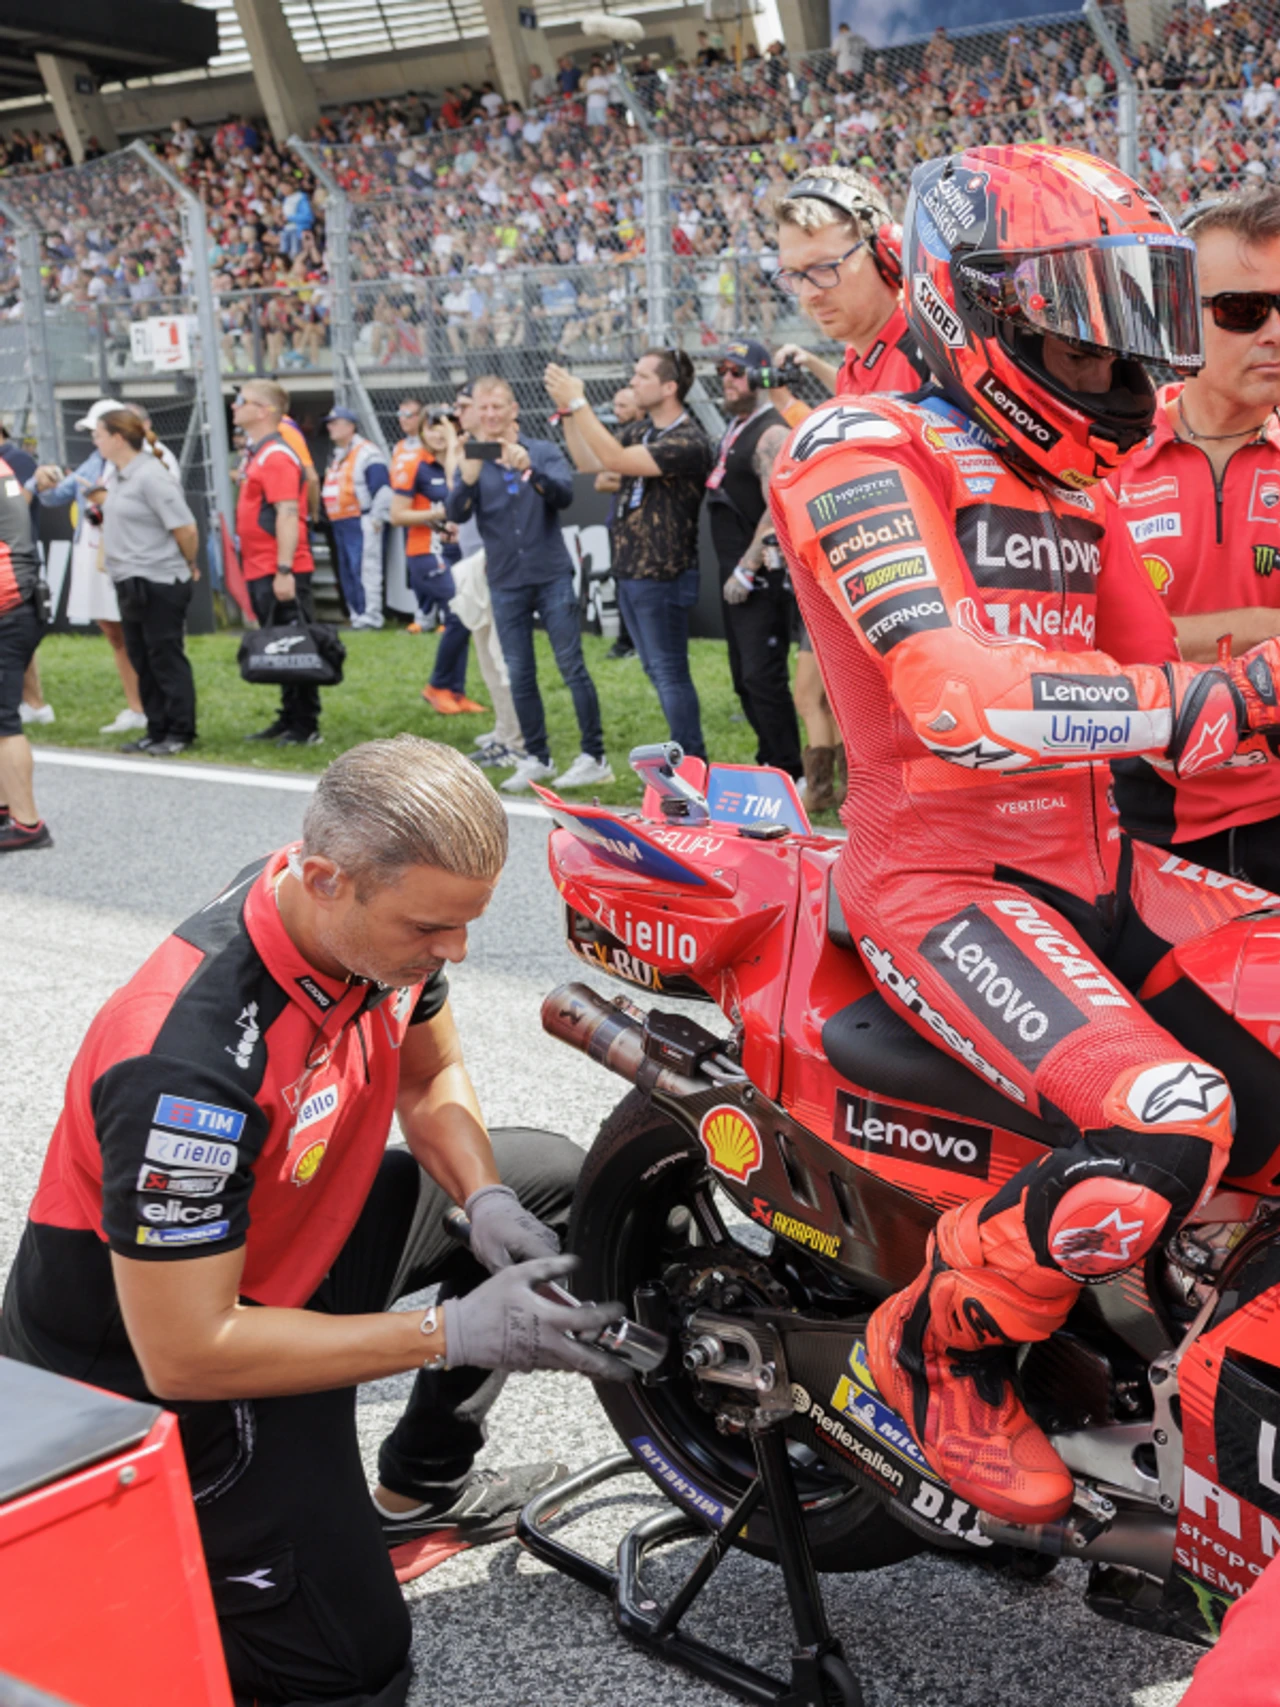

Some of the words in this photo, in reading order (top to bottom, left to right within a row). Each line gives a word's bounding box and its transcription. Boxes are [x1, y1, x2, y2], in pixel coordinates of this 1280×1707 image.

[917, 280, 960, 342] SHOEI
[982, 377, 1051, 442] Lenovo
[976, 520, 1102, 575] Lenovo
[1134, 517, 1176, 540] riello
[1040, 680, 1130, 702] Lenovo
[1051, 715, 1131, 750] Unipol
[742, 794, 782, 819] TIM
[996, 796, 1067, 815] VERTICAL
[994, 899, 1131, 1009] DUCATI
[940, 920, 1050, 1042] Lenovo
[860, 936, 1027, 1103] alpinestars
[197, 1108, 234, 1133] TIM
[845, 1104, 977, 1163] Lenovo
[171, 1140, 232, 1167] riello
[143, 1199, 224, 1223] elica
[809, 1403, 905, 1488] Reflexallen
[638, 1443, 720, 1517] MICHELIN
[1175, 1547, 1249, 1596] SIEM
